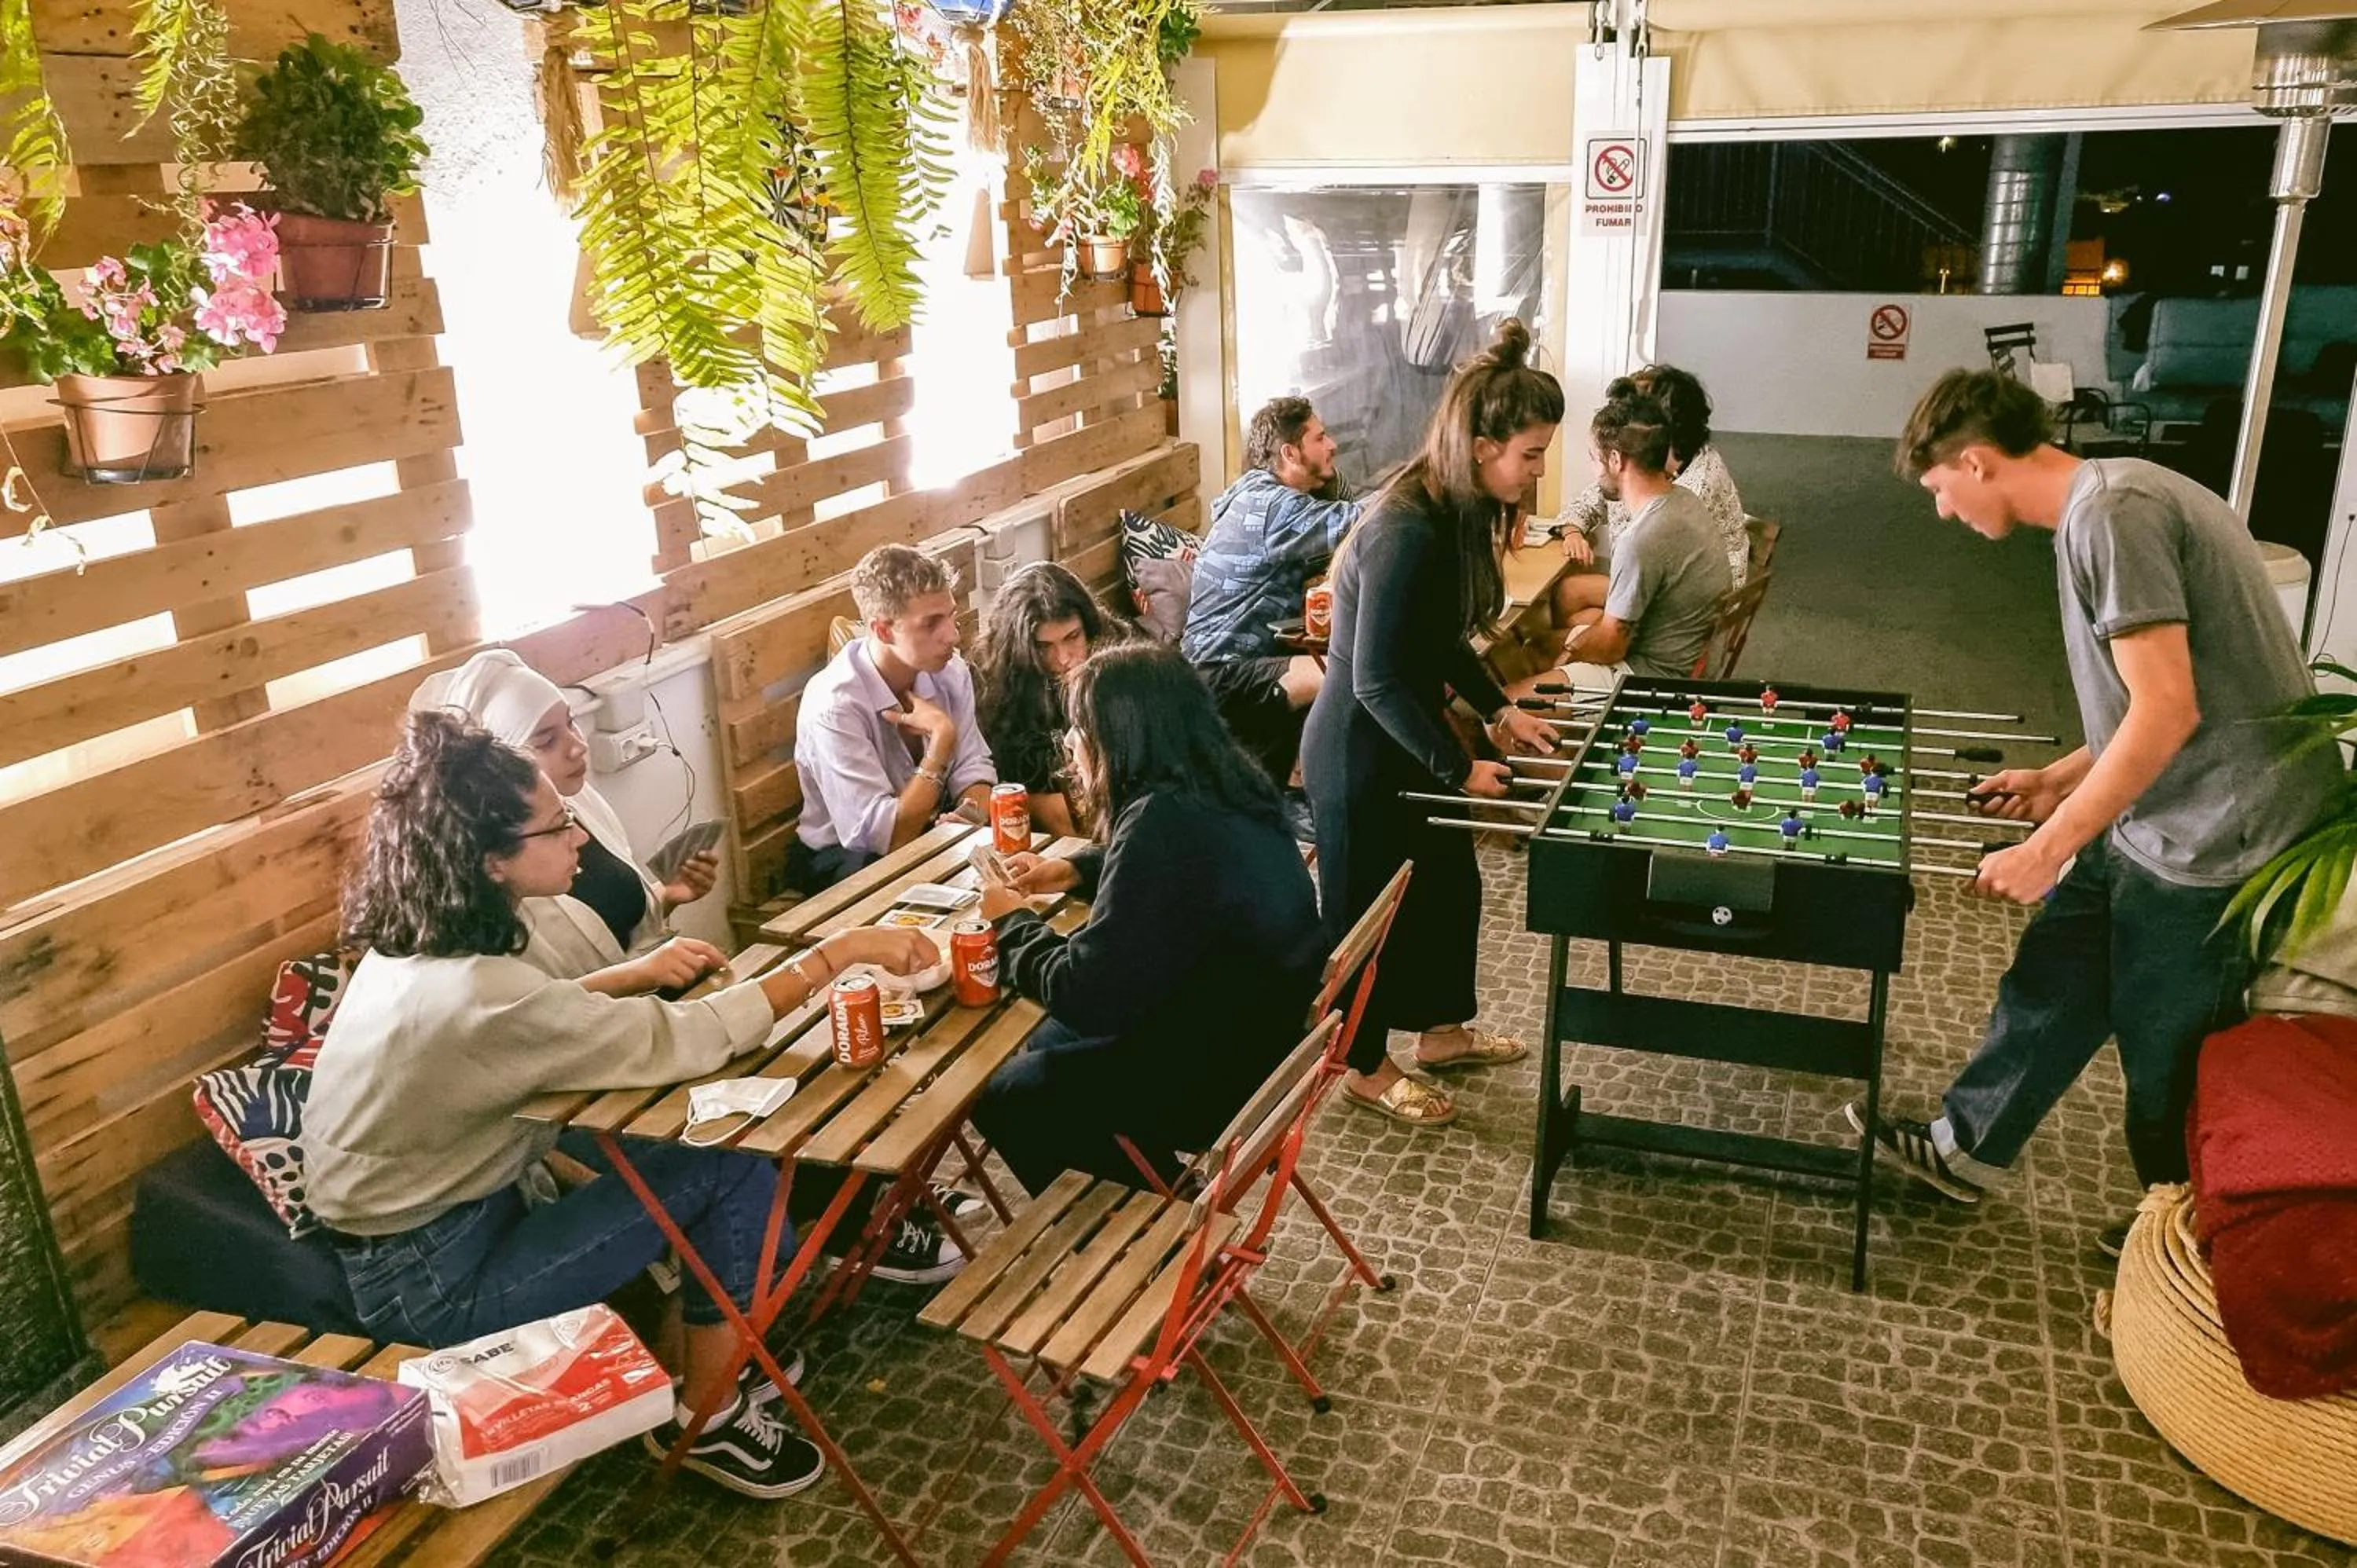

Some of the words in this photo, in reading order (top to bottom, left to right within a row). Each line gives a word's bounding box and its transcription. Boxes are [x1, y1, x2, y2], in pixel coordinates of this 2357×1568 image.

[1585, 204, 1643, 213] PROHIBIO
[1596, 218, 1632, 227] FUMAR
[834, 1000, 852, 1064] DORADA
[0, 1420, 124, 1526] Trivial
[116, 1355, 232, 1453] Pursuit
[236, 1499, 318, 1568] Trivial
[307, 1445, 392, 1546] Pursuit
